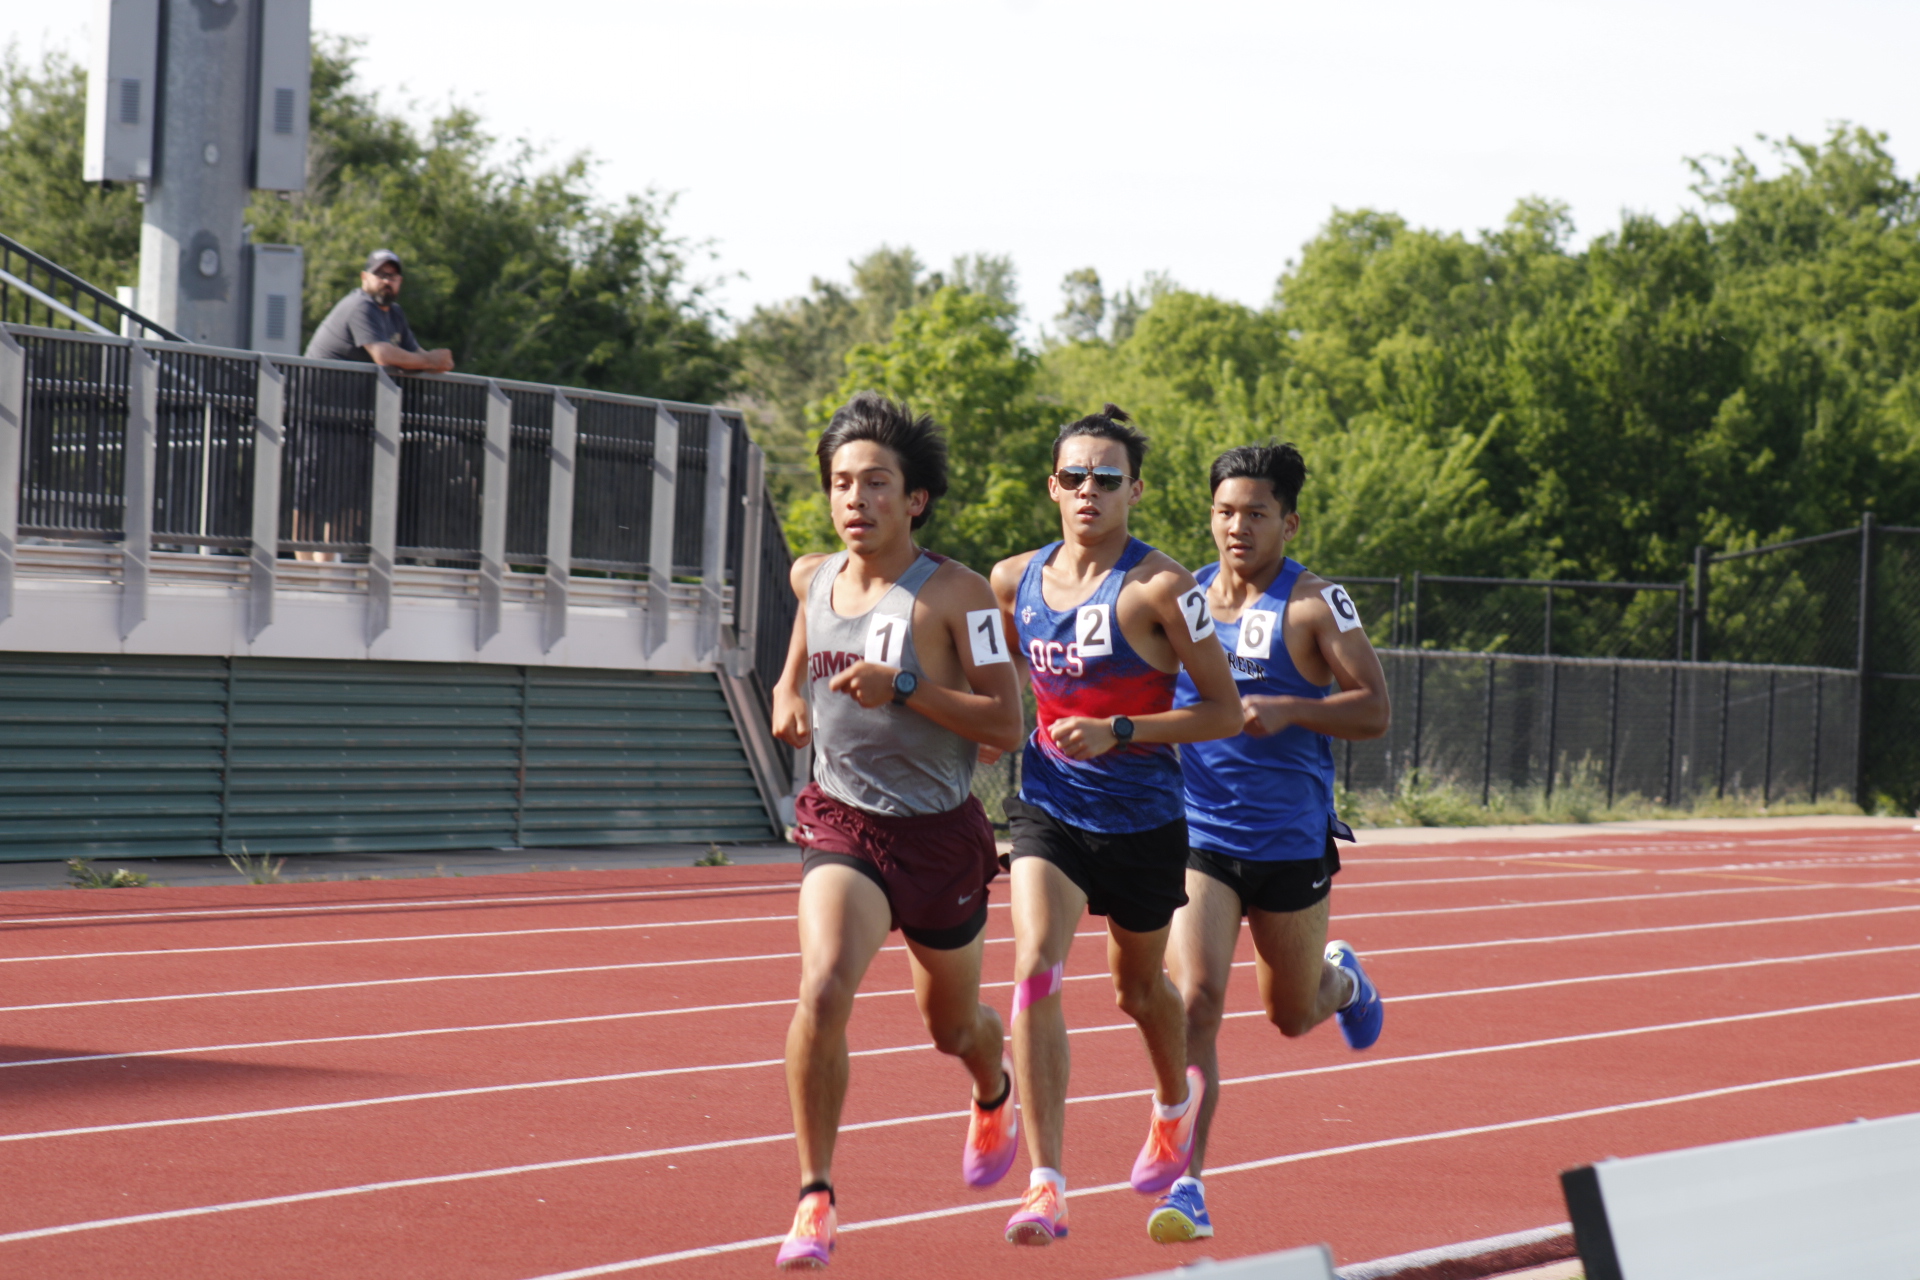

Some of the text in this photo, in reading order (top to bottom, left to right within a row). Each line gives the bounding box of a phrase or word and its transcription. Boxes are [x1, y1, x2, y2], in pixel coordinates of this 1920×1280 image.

[1186, 591, 1211, 632] 2
[1330, 588, 1354, 620] 6
[875, 622, 894, 662] 1
[977, 614, 999, 655] 1
[1083, 608, 1105, 646] 2
[1244, 613, 1267, 648] 6
[1029, 638, 1084, 677] OCS
[1227, 652, 1267, 682] REEK
